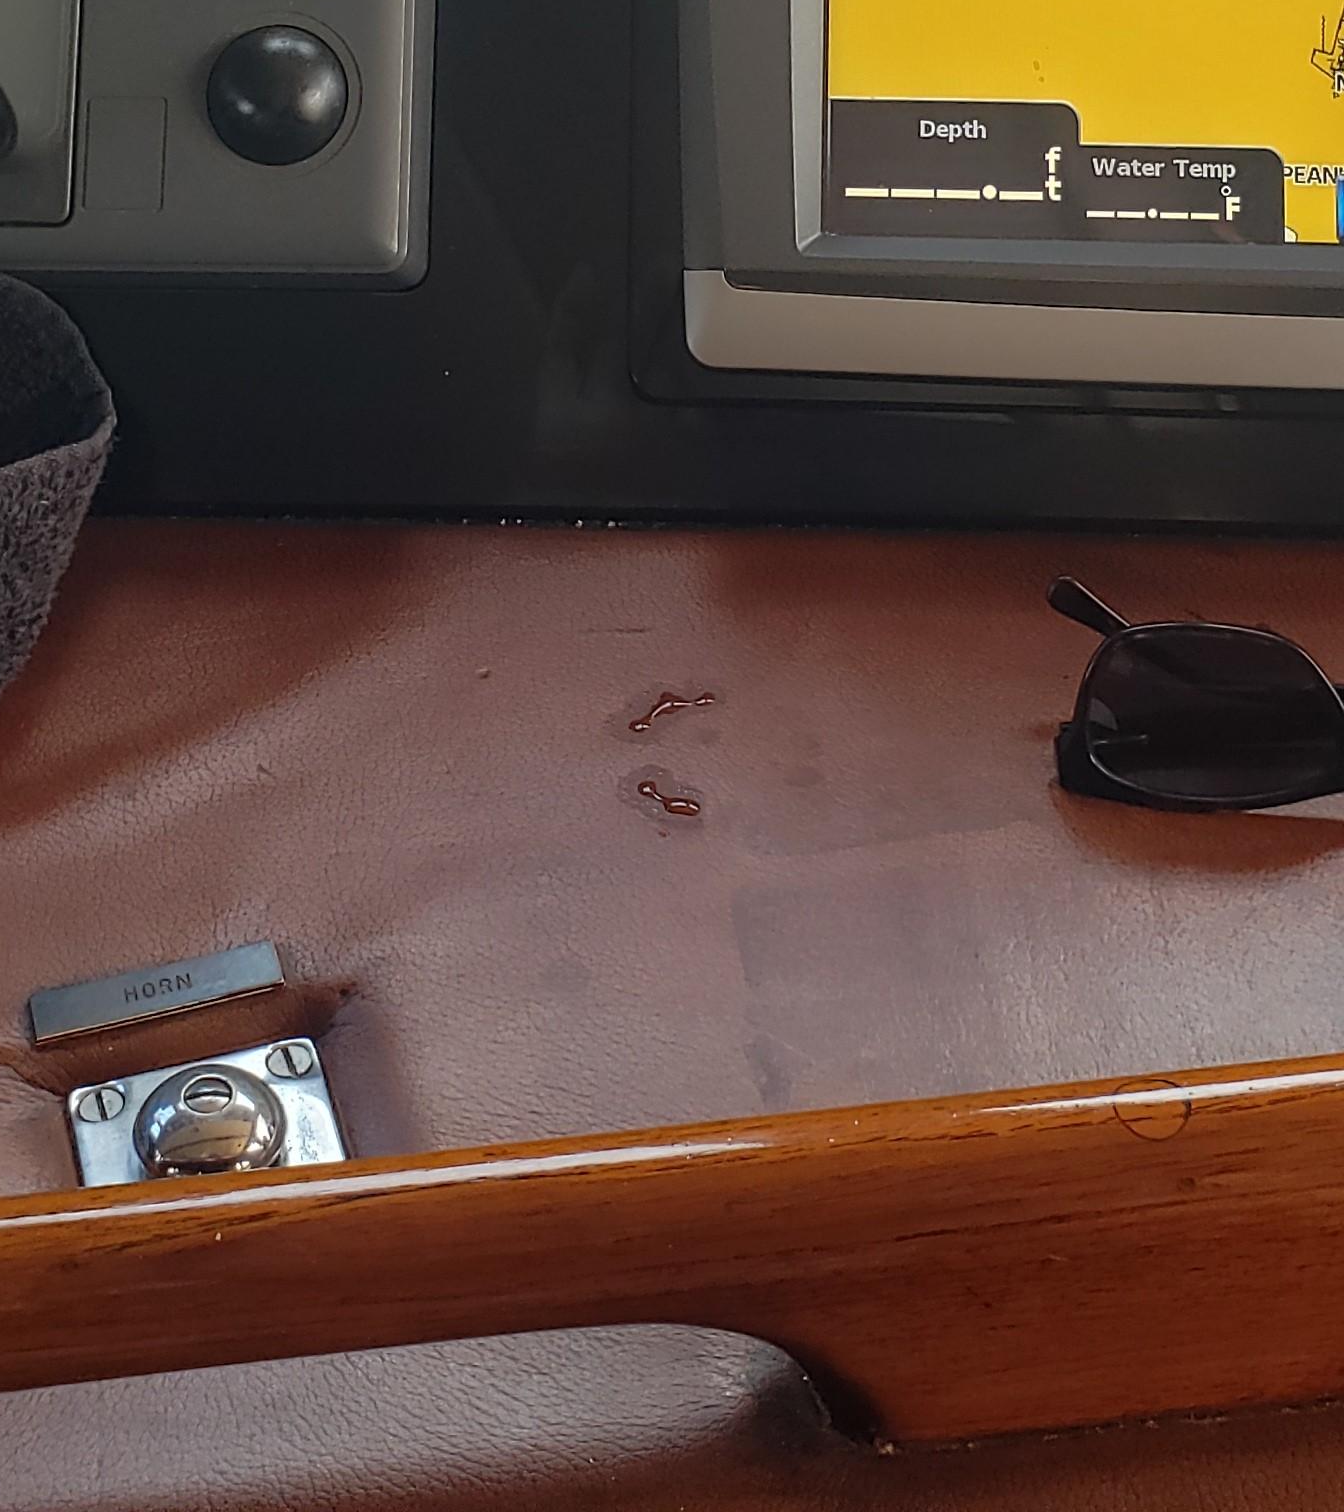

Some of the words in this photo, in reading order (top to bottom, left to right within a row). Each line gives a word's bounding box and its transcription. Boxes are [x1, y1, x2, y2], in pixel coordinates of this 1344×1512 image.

[918, 119, 988, 142] Depth
[1092, 157, 1165, 178] Water
[1173, 158, 1237, 183] Temp
[124, 973, 193, 1003] HORN
